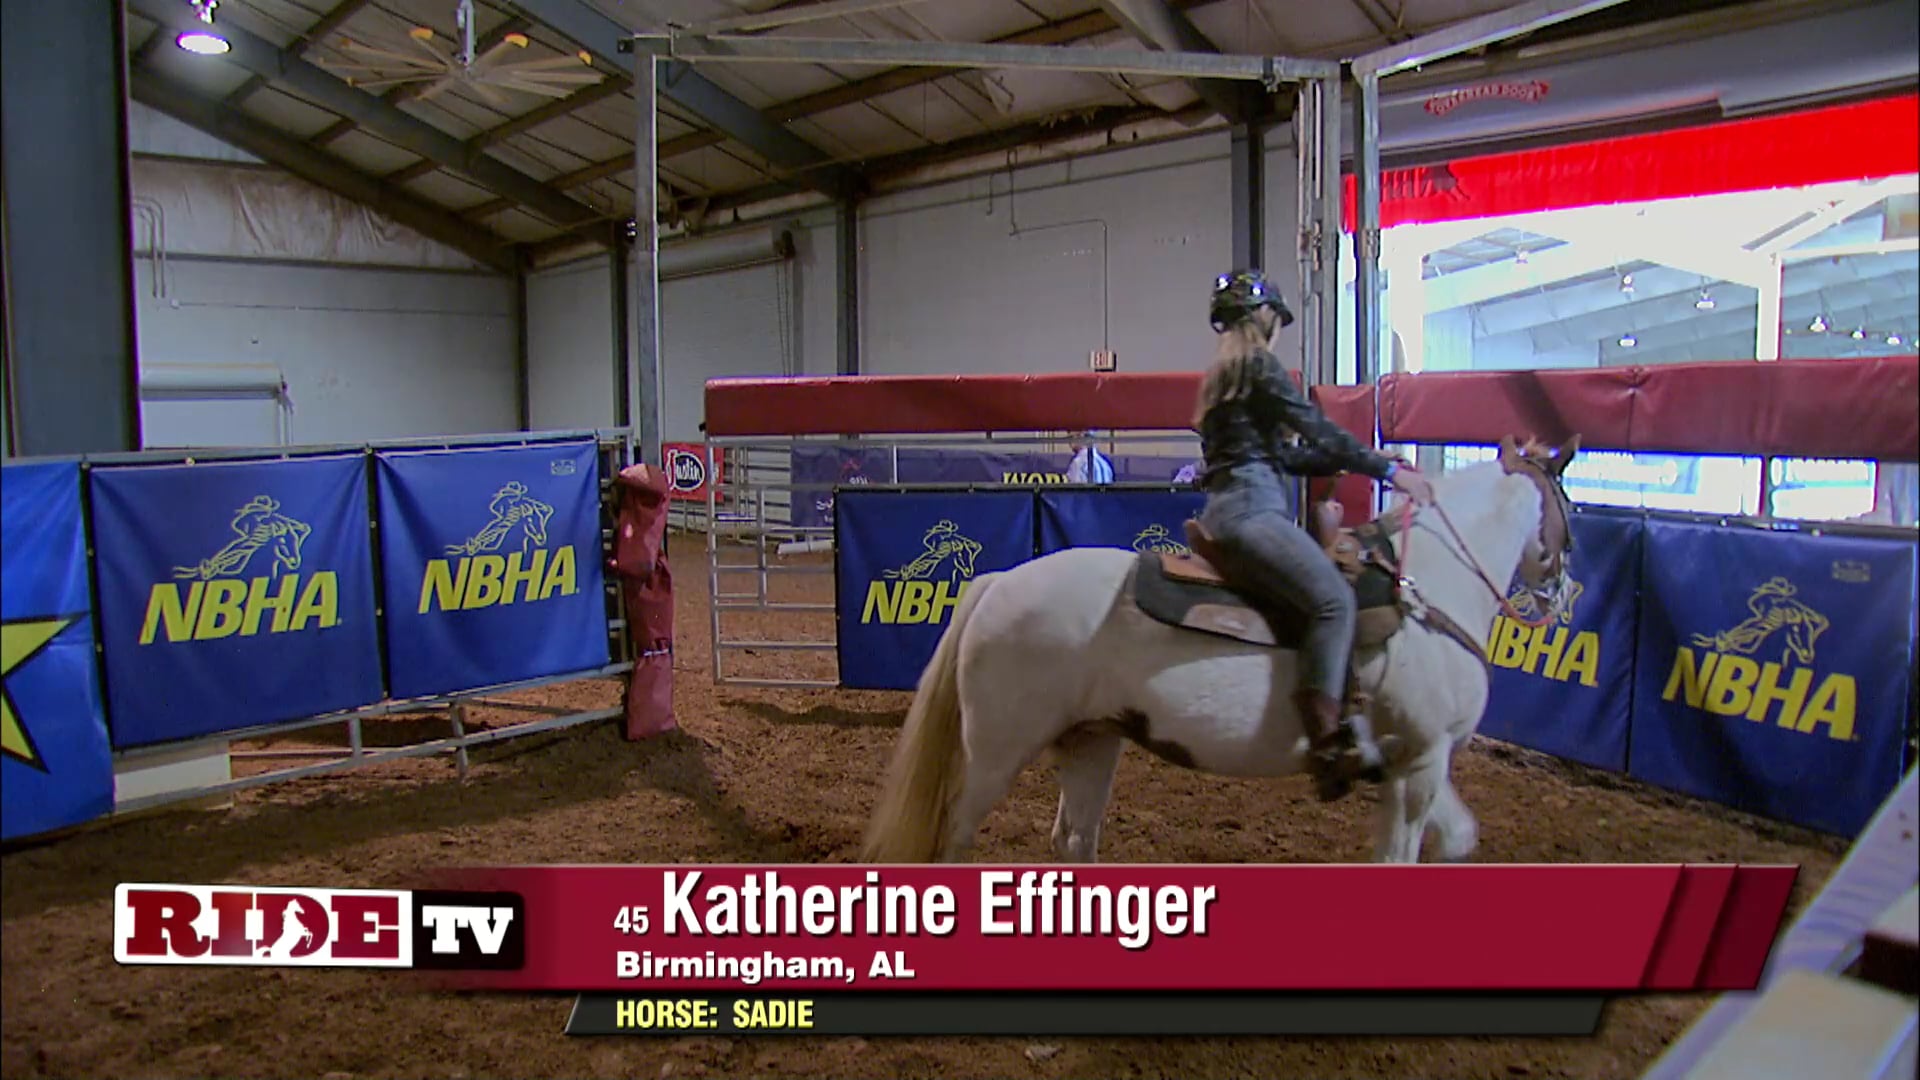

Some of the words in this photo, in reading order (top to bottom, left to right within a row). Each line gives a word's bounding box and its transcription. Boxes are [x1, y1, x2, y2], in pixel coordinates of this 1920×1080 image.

[140, 571, 338, 645] NBHA
[419, 547, 576, 613] NBHA
[861, 580, 972, 624] NBH
[1664, 648, 1856, 739] NBHA
